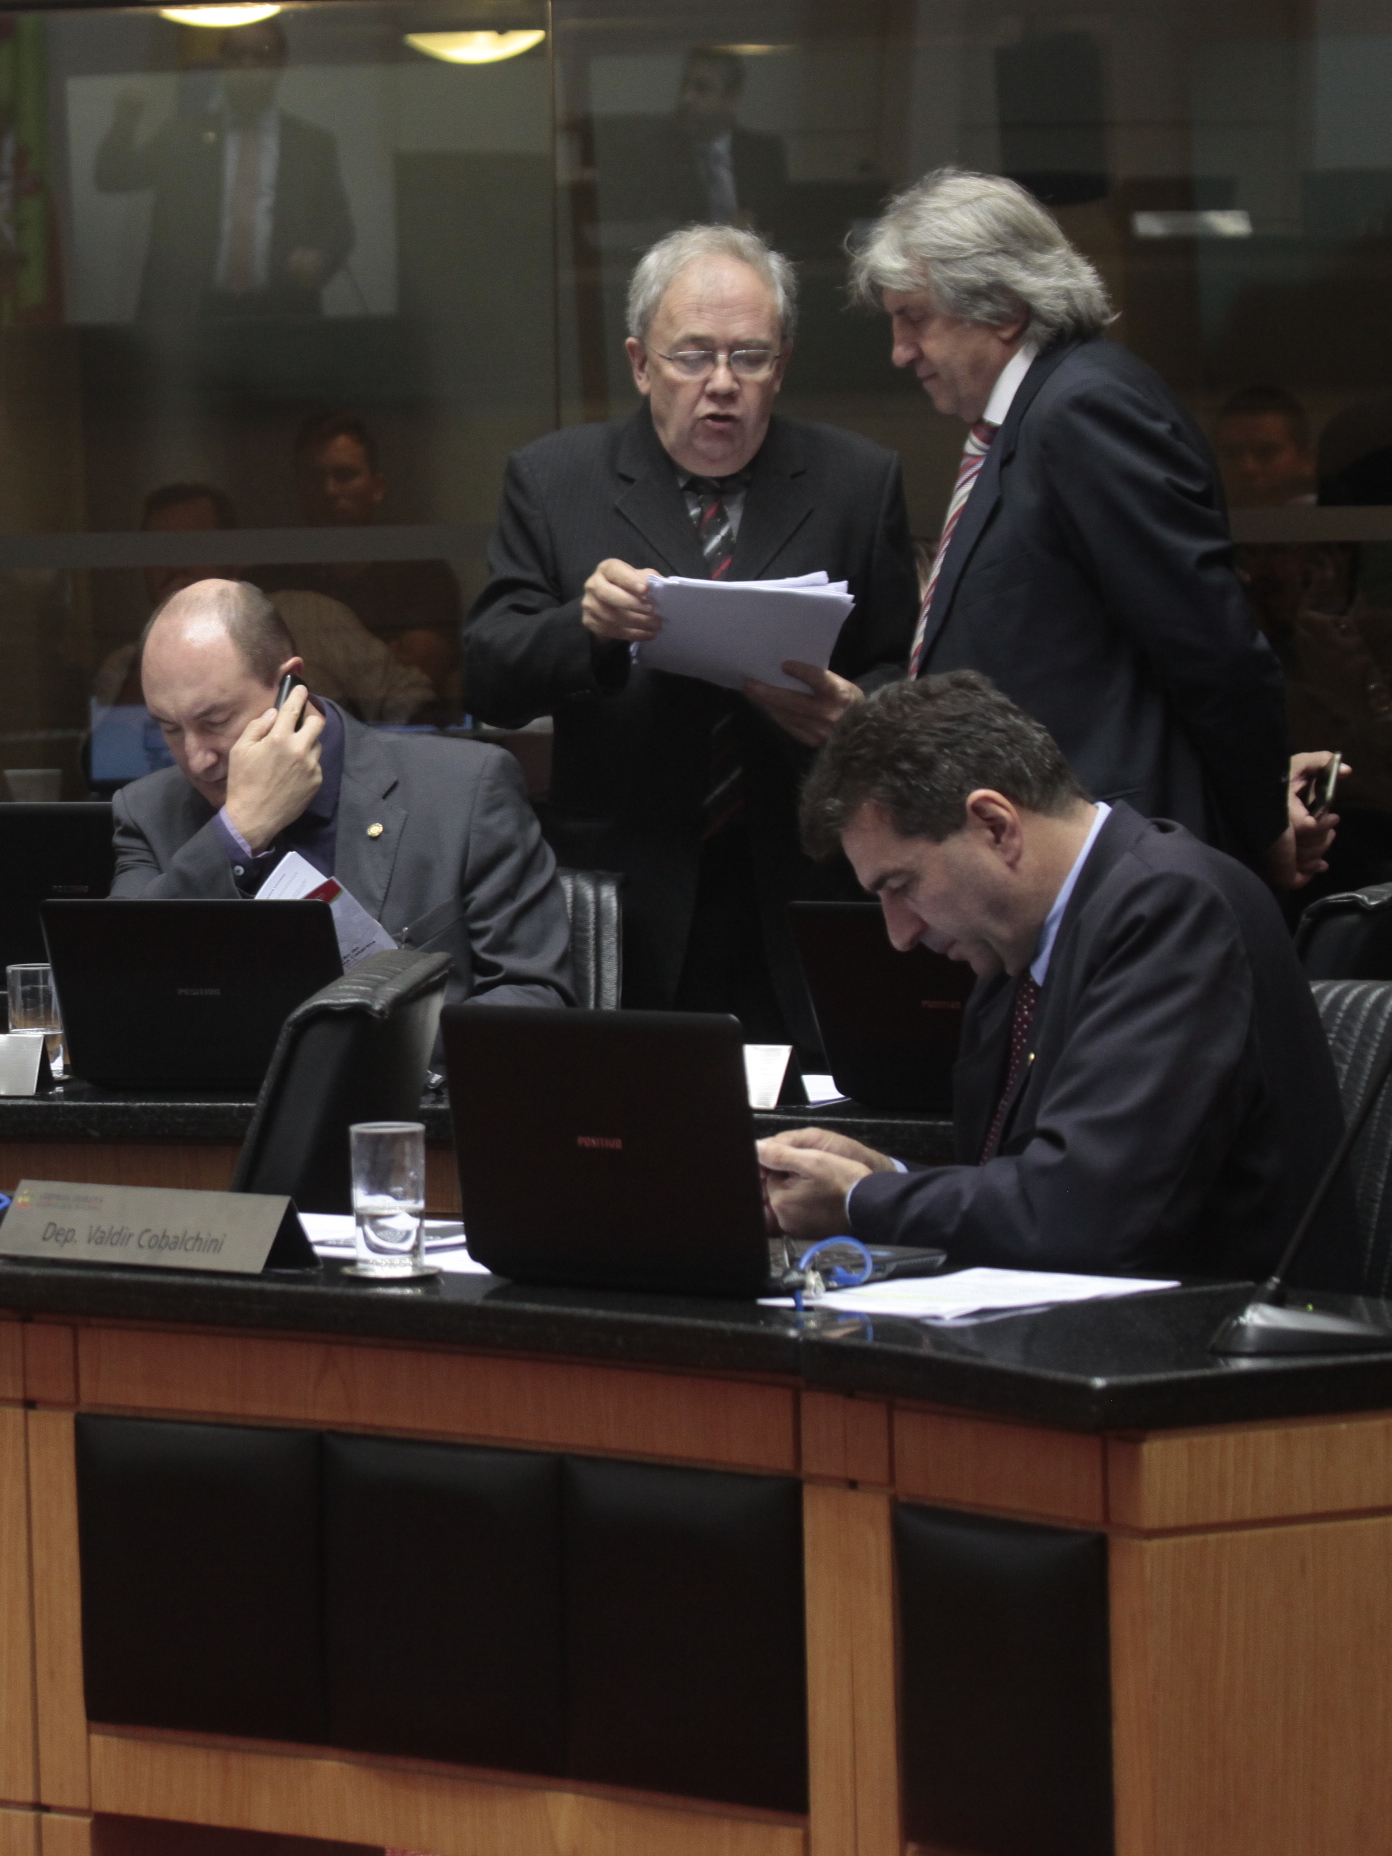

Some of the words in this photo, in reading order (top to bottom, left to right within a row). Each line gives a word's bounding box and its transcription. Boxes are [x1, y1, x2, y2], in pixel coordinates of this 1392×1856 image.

[41, 1221, 77, 1248] Dep.
[86, 1224, 132, 1248] Valdir
[137, 1228, 227, 1254] Cobalchini
